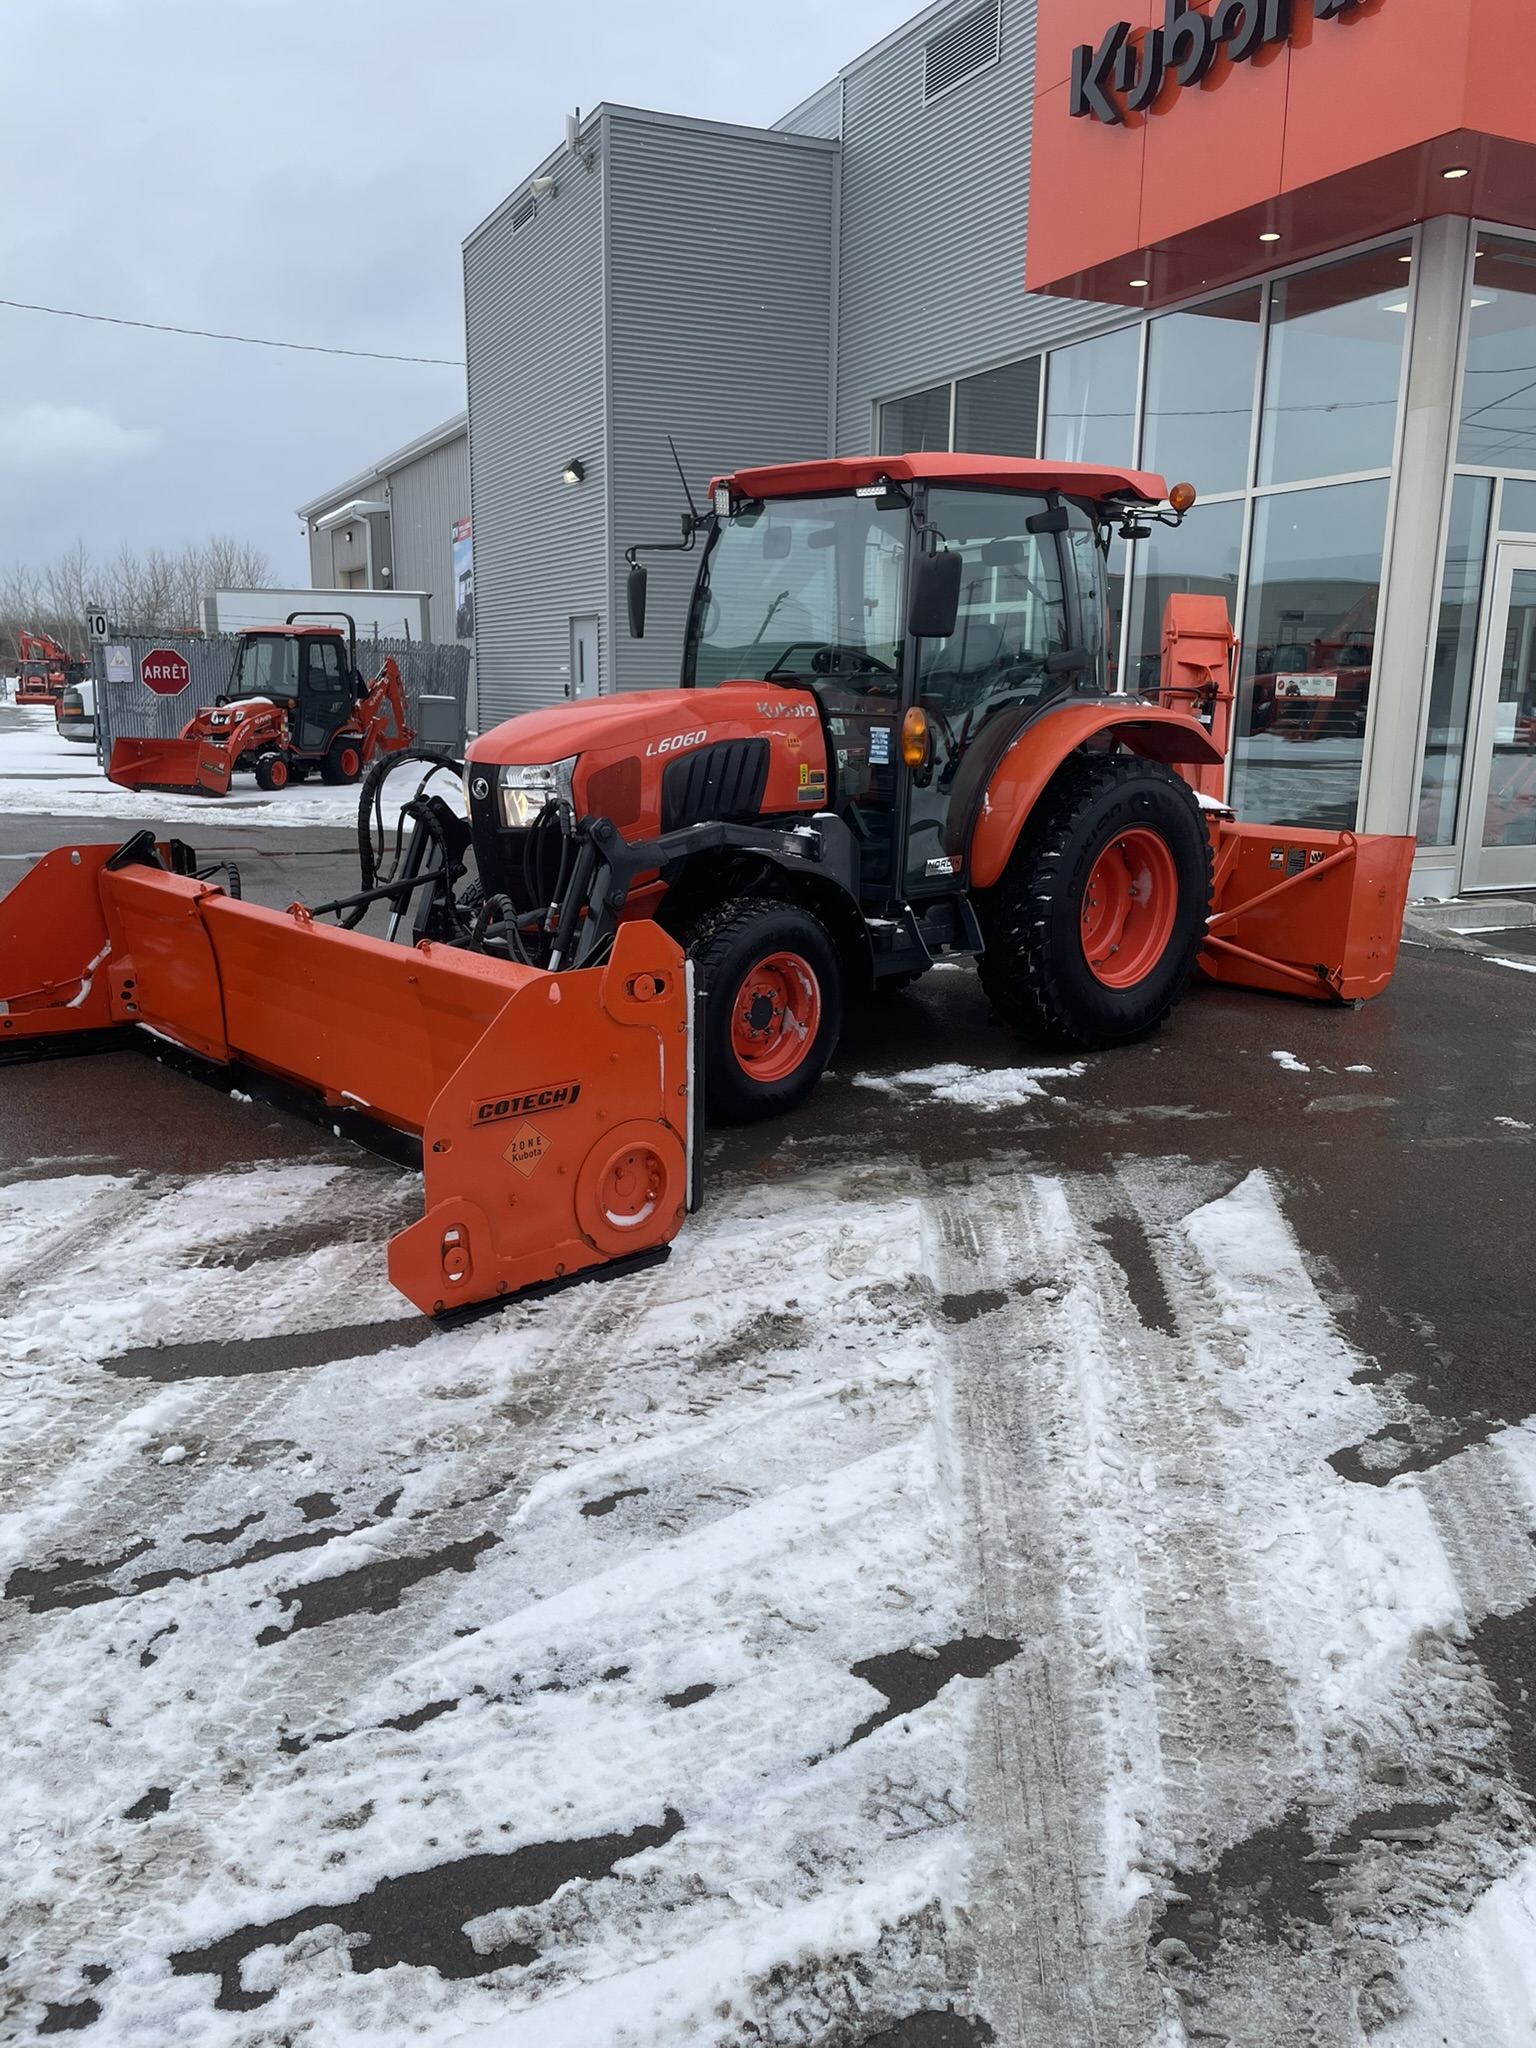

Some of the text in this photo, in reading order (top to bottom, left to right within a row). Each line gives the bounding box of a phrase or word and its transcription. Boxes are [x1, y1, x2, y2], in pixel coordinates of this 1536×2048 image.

[88, 616, 106, 635] 10
[144, 663, 187, 679] ARRÊT
[756, 701, 816, 719] Kubota
[645, 729, 707, 757] L6060
[478, 1087, 568, 1119] COTECH
[511, 1136, 542, 1152] ZONE
[512, 1148, 543, 1163] Kubota
